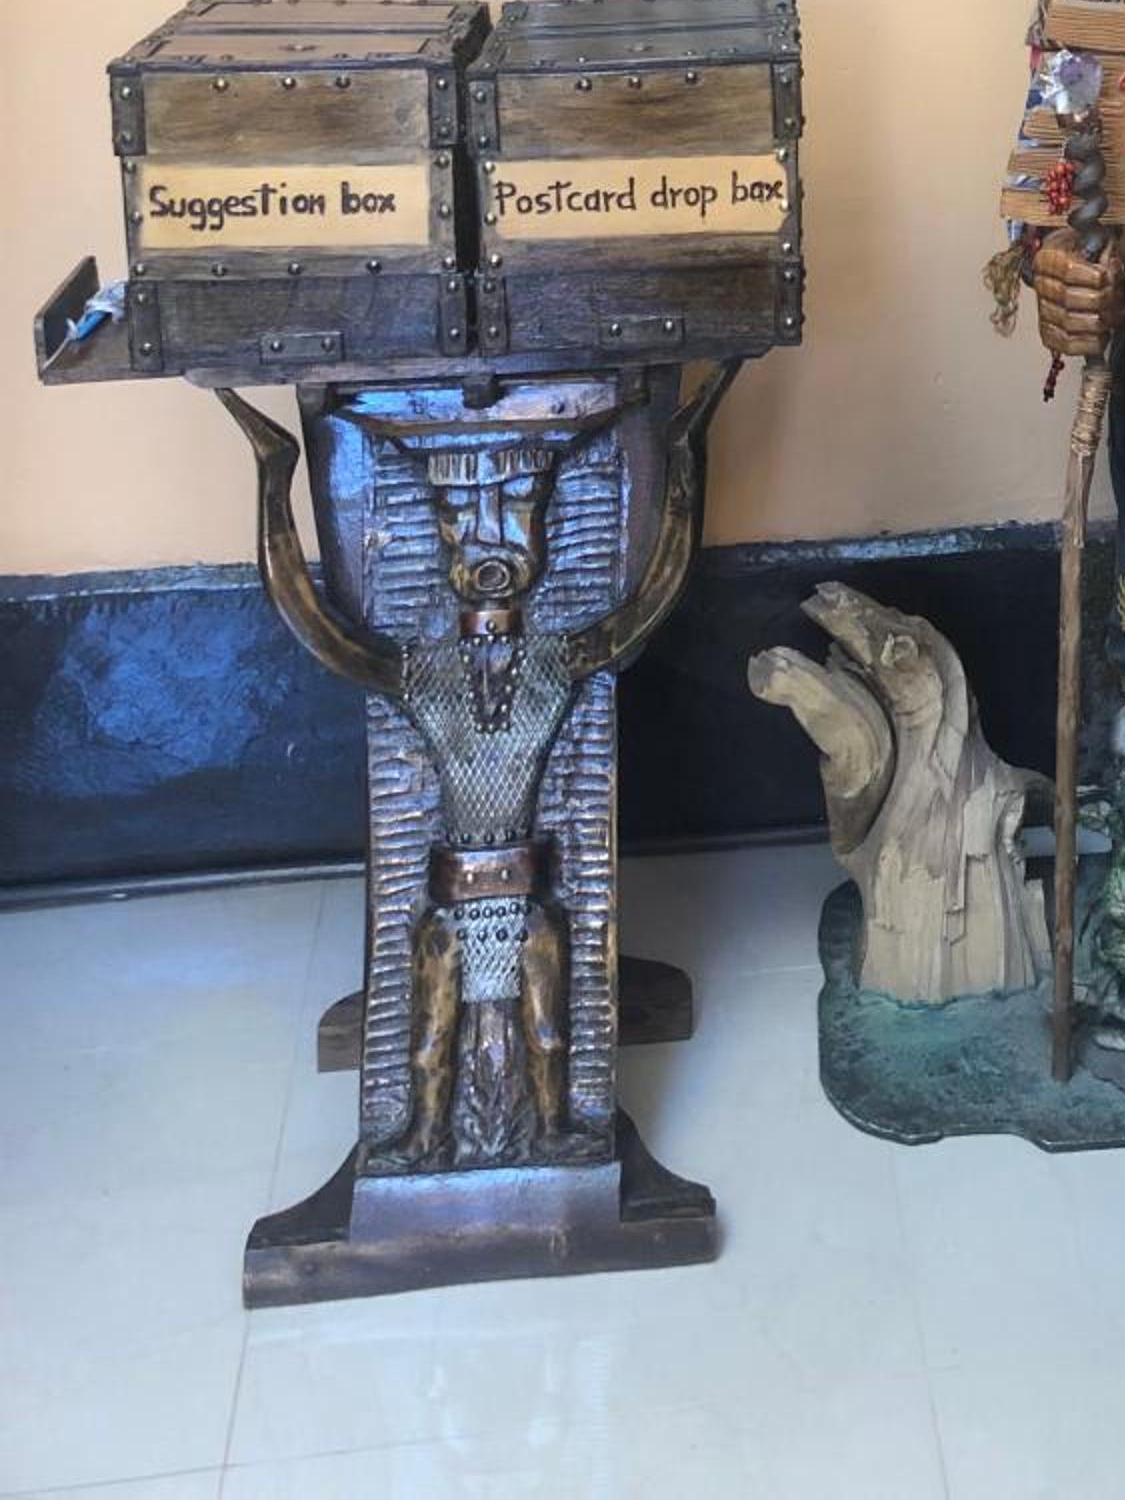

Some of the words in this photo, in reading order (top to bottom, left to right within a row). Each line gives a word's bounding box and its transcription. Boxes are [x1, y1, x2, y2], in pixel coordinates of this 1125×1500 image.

[149, 182, 326, 231] Suggestion
[340, 181, 397, 215] box
[494, 176, 637, 216] Postcard
[650, 175, 718, 218] drop
[730, 170, 784, 205] box
